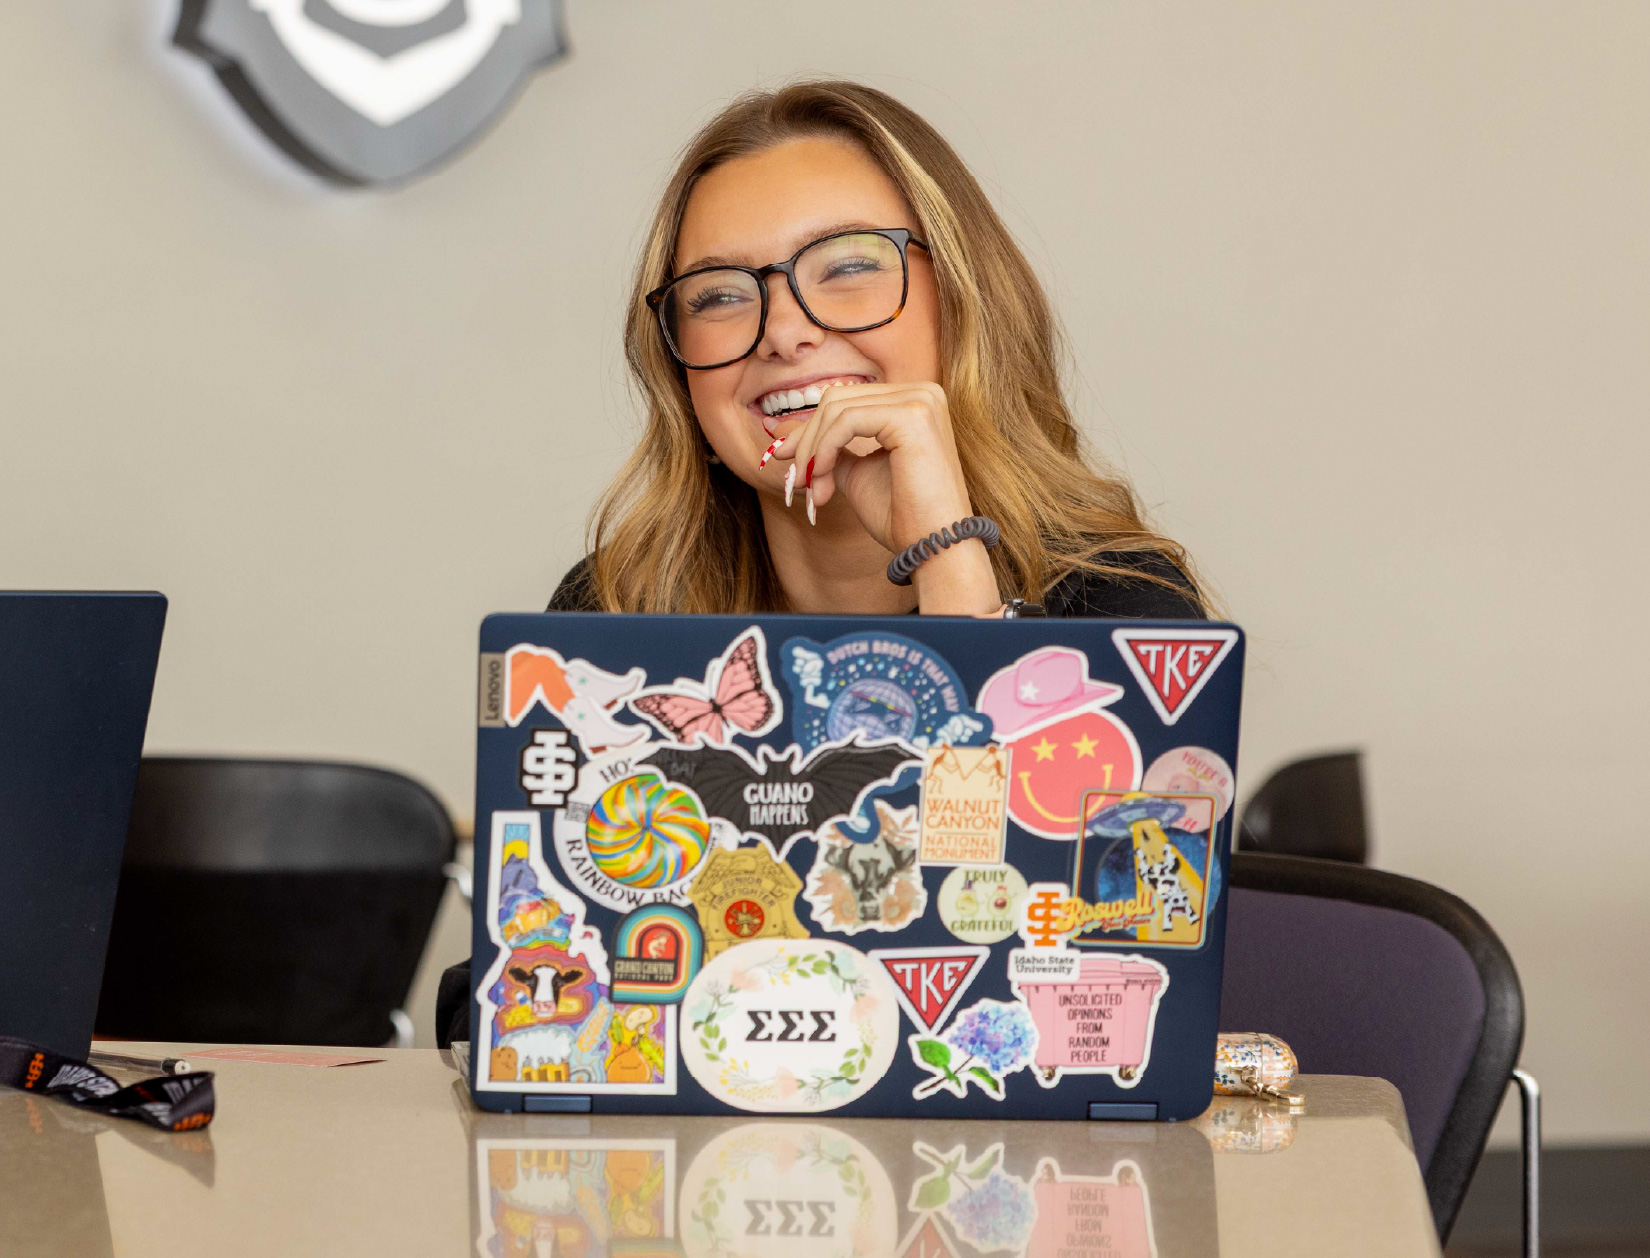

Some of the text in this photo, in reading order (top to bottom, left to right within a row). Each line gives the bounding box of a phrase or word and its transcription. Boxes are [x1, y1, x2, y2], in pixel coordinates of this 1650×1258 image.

[872, 640, 908, 659] BROS
[908, 650, 923, 665] IS
[1137, 644, 1214, 697] TKE
[485, 661, 501, 720] Lenovo
[743, 782, 814, 804] GUANO
[926, 798, 1000, 814] WALNUT
[749, 804, 809, 825] HAPPENS
[926, 814, 1000, 830] CANYON
[926, 835, 996, 848] NATIONAL
[924, 848, 996, 859] MONUMENT
[566, 838, 645, 906] RAINBOW
[964, 870, 1007, 883] TRULY
[722, 876, 762, 890] JUNIOR
[1056, 892, 1155, 932] Roswell
[951, 920, 1014, 932] GRATEFUL
[1015, 956, 1074, 965] Idaho State
[1016, 965, 1072, 975] University
[892, 961, 968, 1014] TKE
[1059, 993, 1122, 1006] UNSOLICITED
[1068, 1007, 1113, 1020] OPINIONS
[745, 1011, 836, 1041] ΣΣΣ
[1076, 1022, 1103, 1034] FROM
[1069, 1036, 1110, 1048] RANDOM
[1070, 1050, 1107, 1062] PEOPLE
